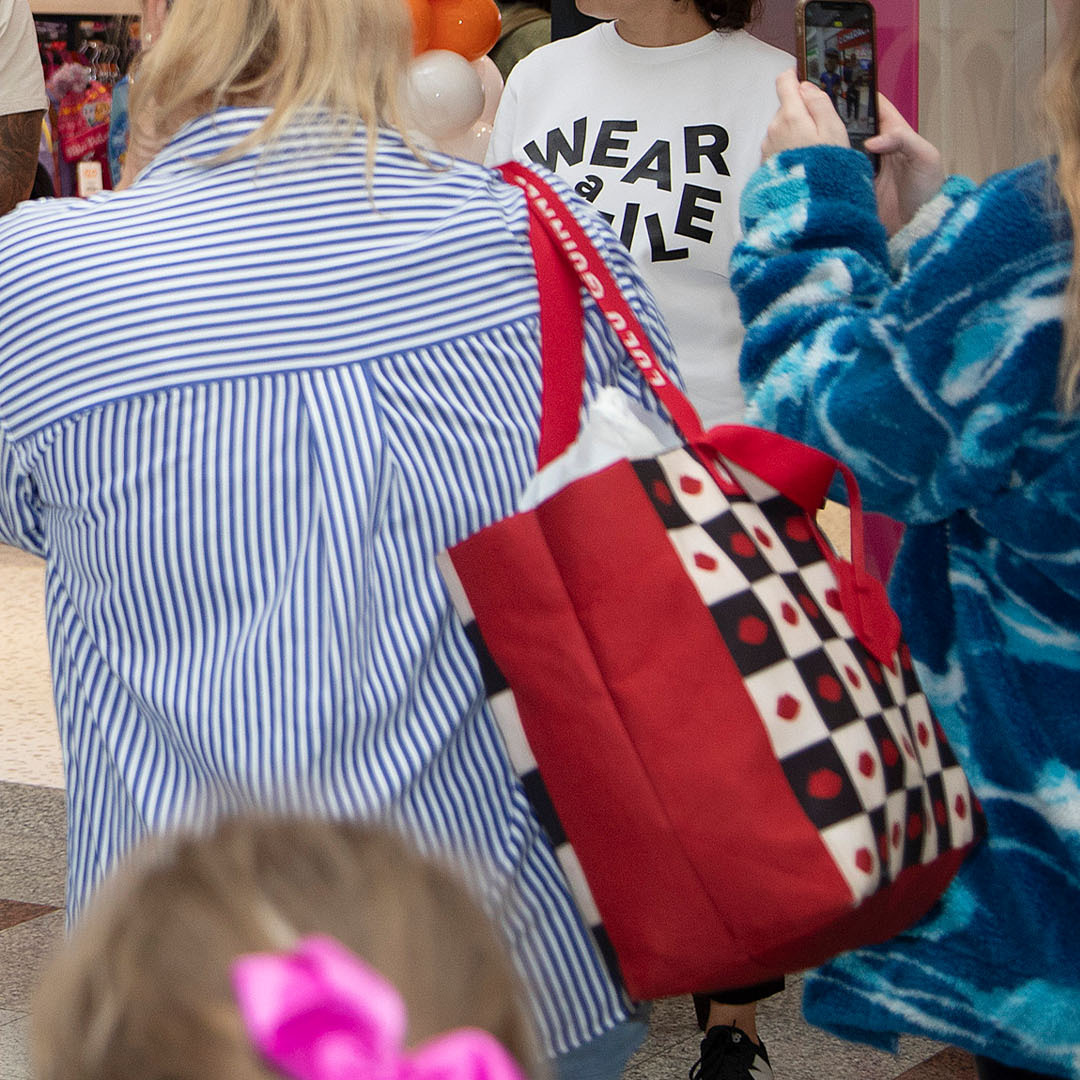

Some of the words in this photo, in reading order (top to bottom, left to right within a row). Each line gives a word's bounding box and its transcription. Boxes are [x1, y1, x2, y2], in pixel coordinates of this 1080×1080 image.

[524, 116, 731, 192] WEAR
[574, 175, 604, 204] a
[605, 310, 668, 387] LULU
